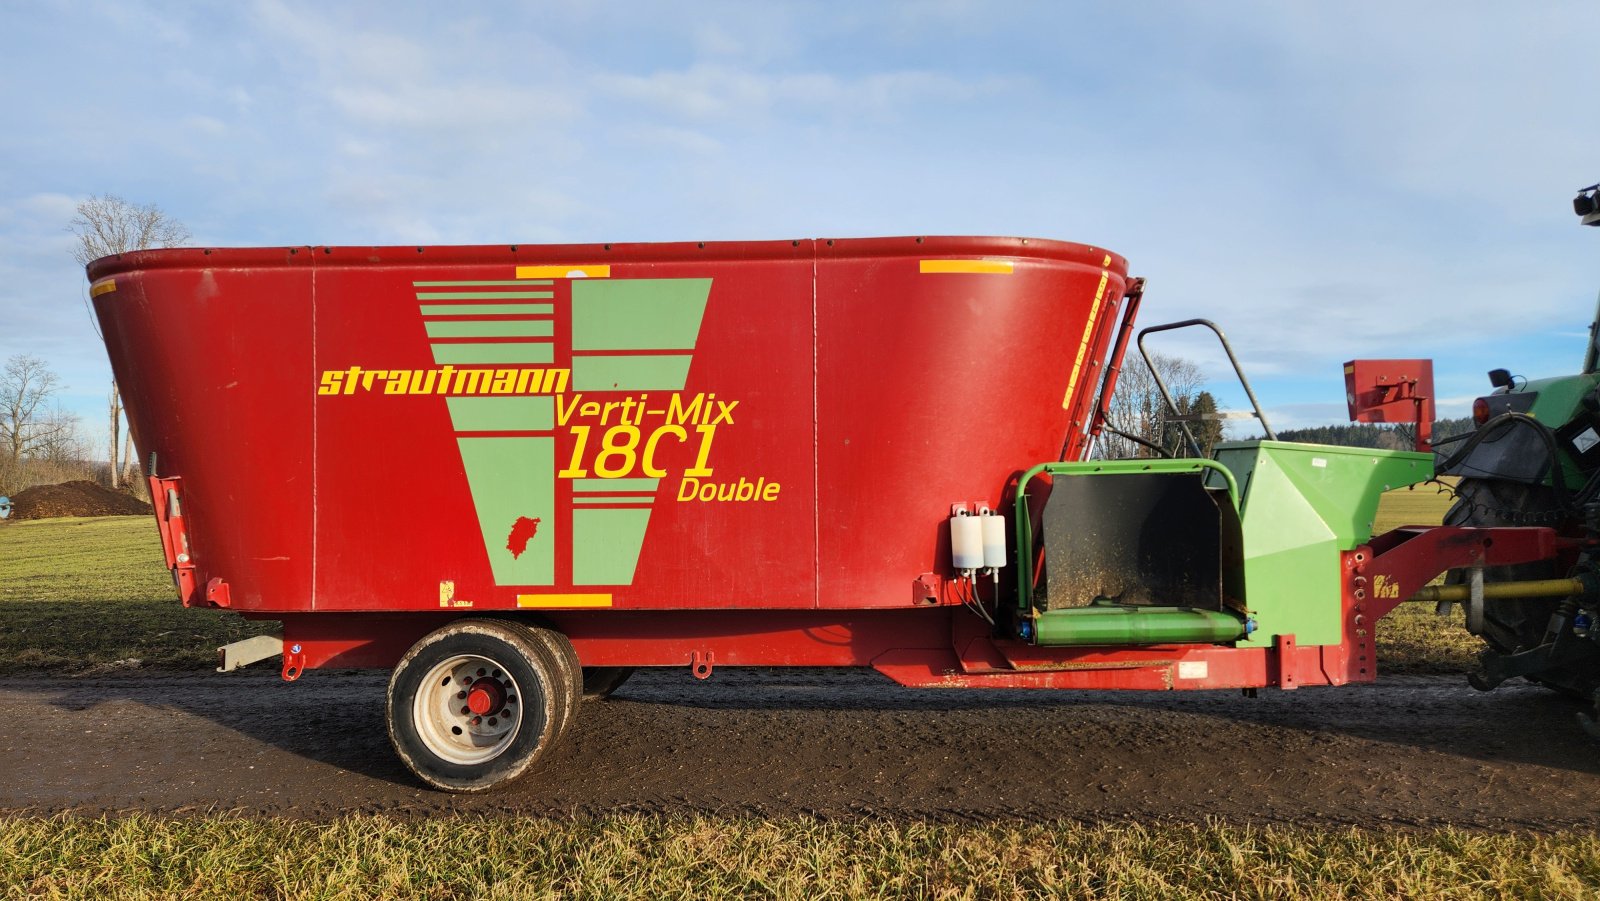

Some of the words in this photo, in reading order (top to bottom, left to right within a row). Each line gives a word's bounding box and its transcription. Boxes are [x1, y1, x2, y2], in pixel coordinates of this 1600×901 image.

[318, 365, 570, 395] strautmann
[556, 392, 739, 426] Verti-Mix
[677, 477, 781, 502] Double
